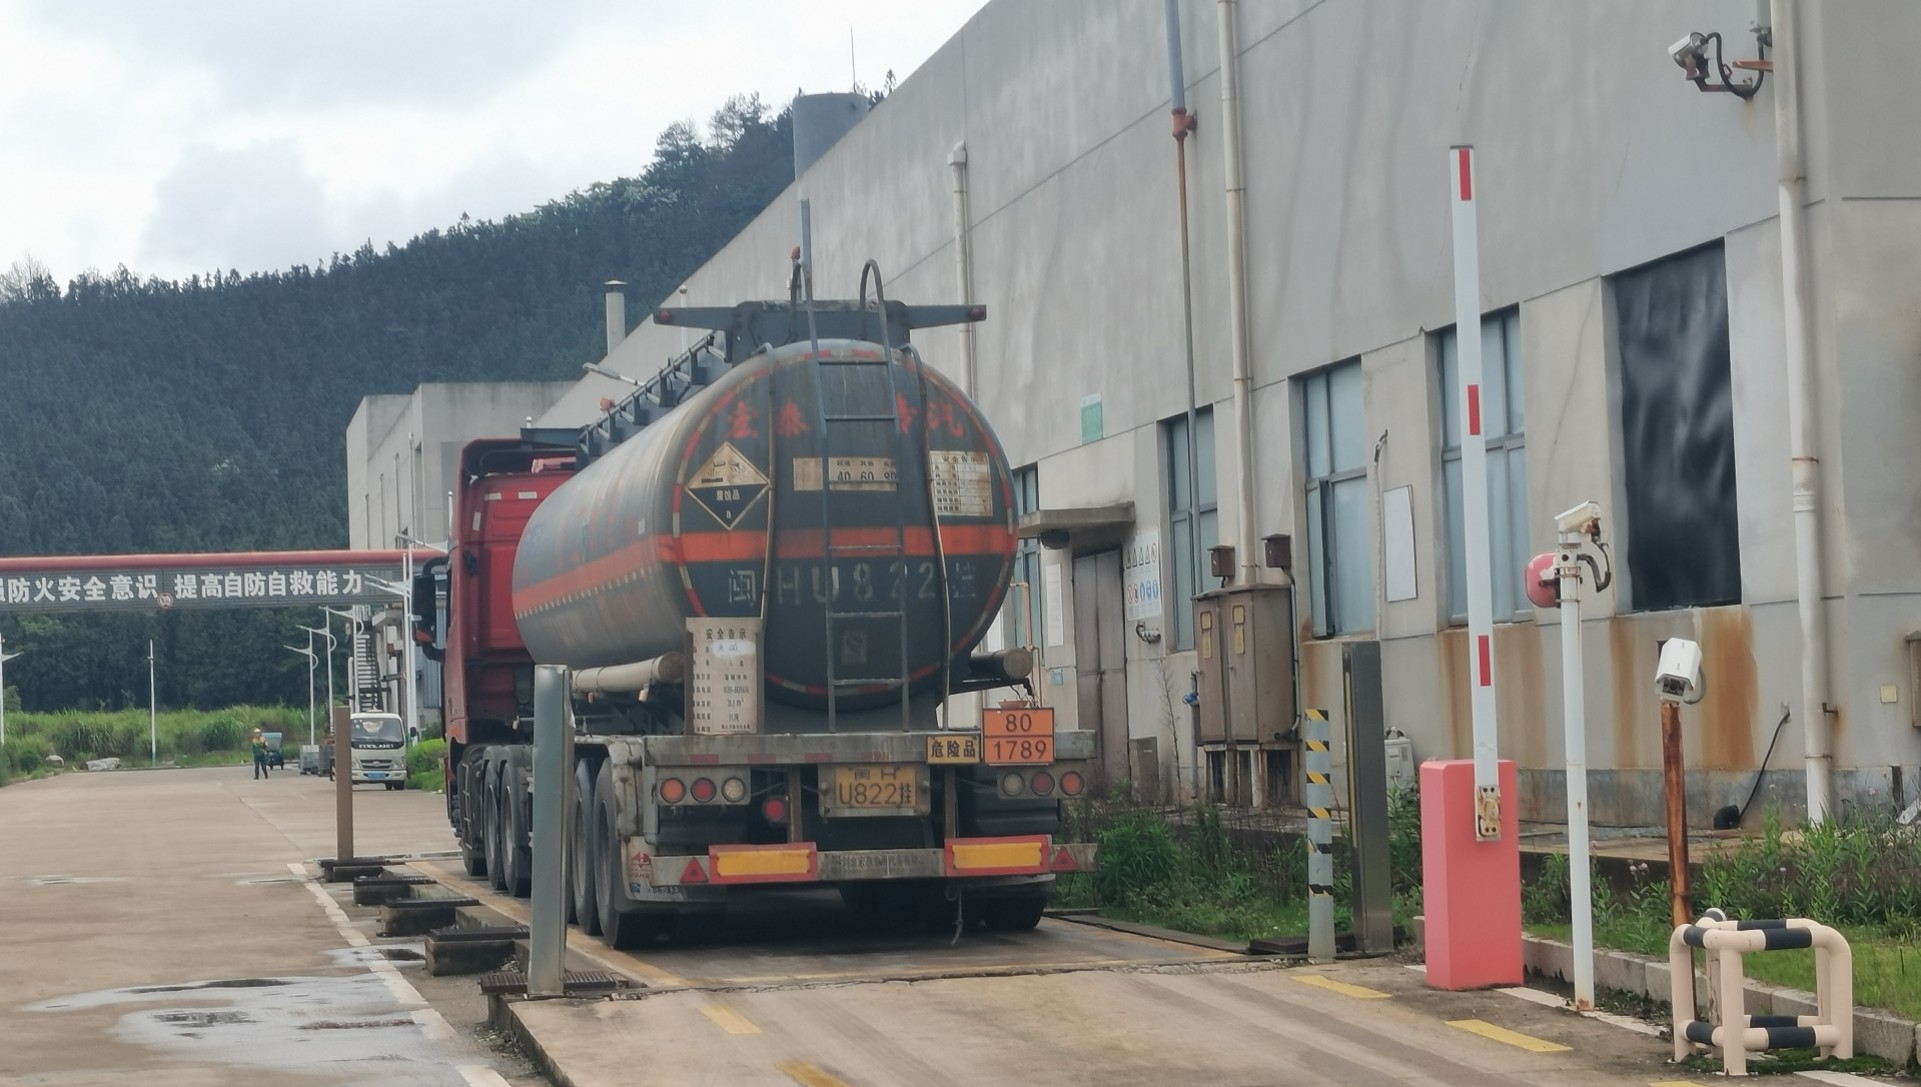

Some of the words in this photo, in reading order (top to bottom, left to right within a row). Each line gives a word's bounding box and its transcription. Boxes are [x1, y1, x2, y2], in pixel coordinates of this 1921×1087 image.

[717, 489, 740, 502] 腐蚀品
[174, 569, 362, 599] 提高自防自救能力
[706, 628, 747, 640] 安全告示
[1006, 713, 1032, 732] 80
[931, 740, 976, 758] 危险品
[994, 740, 1047, 760] 1789
[839, 782, 912, 805] U822挂
